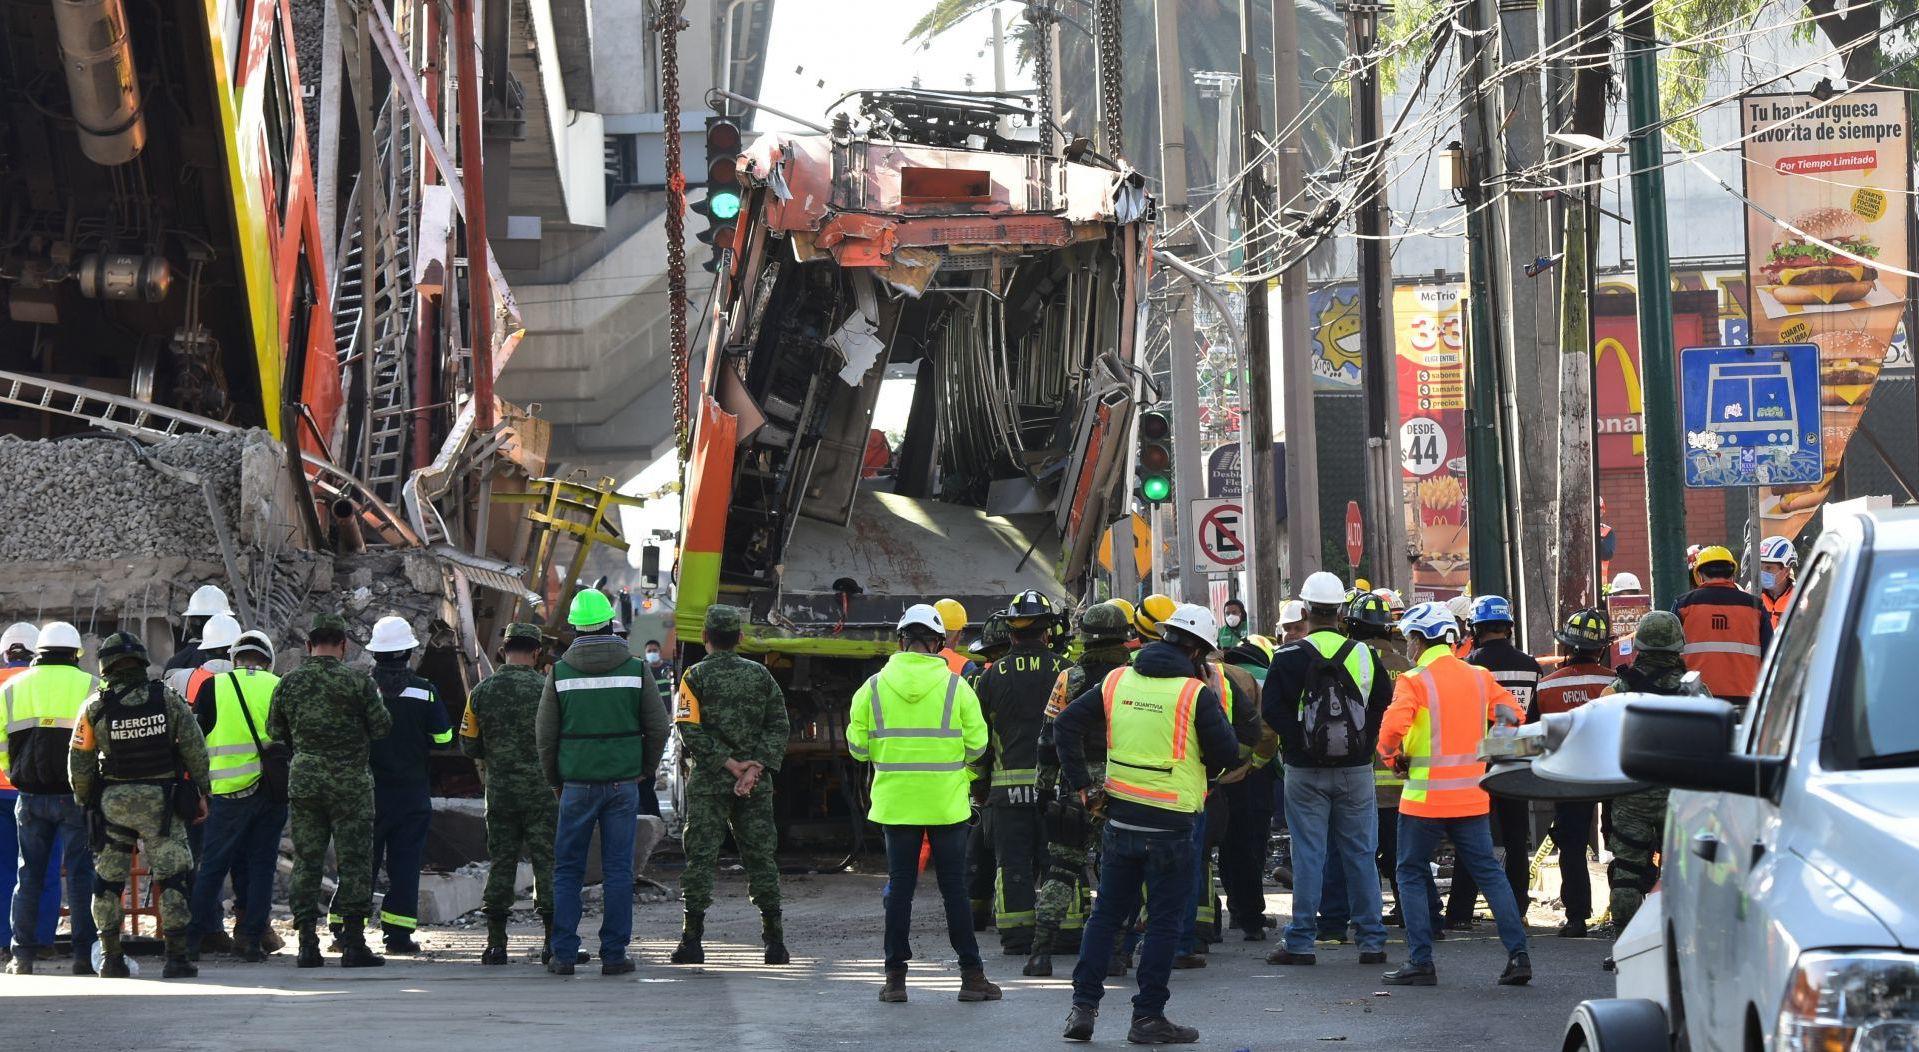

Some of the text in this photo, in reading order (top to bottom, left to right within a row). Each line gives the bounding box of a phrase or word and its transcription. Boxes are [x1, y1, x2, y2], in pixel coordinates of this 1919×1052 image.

[1750, 101, 1878, 123] Tu hamburguesa
[1750, 121, 1902, 143] favorita de siempre
[1780, 156, 1875, 171] Por Tiempo Limitado
[1780, 322, 1805, 340] CUARTO
[1431, 371, 1461, 379] sabores
[1433, 400, 1459, 409] precios
[1407, 424, 1435, 435] DESDE
[1347, 522, 1362, 547] ALTO
[1562, 689, 1590, 704] OFICIAL
[111, 713, 166, 730] EJERCITO
